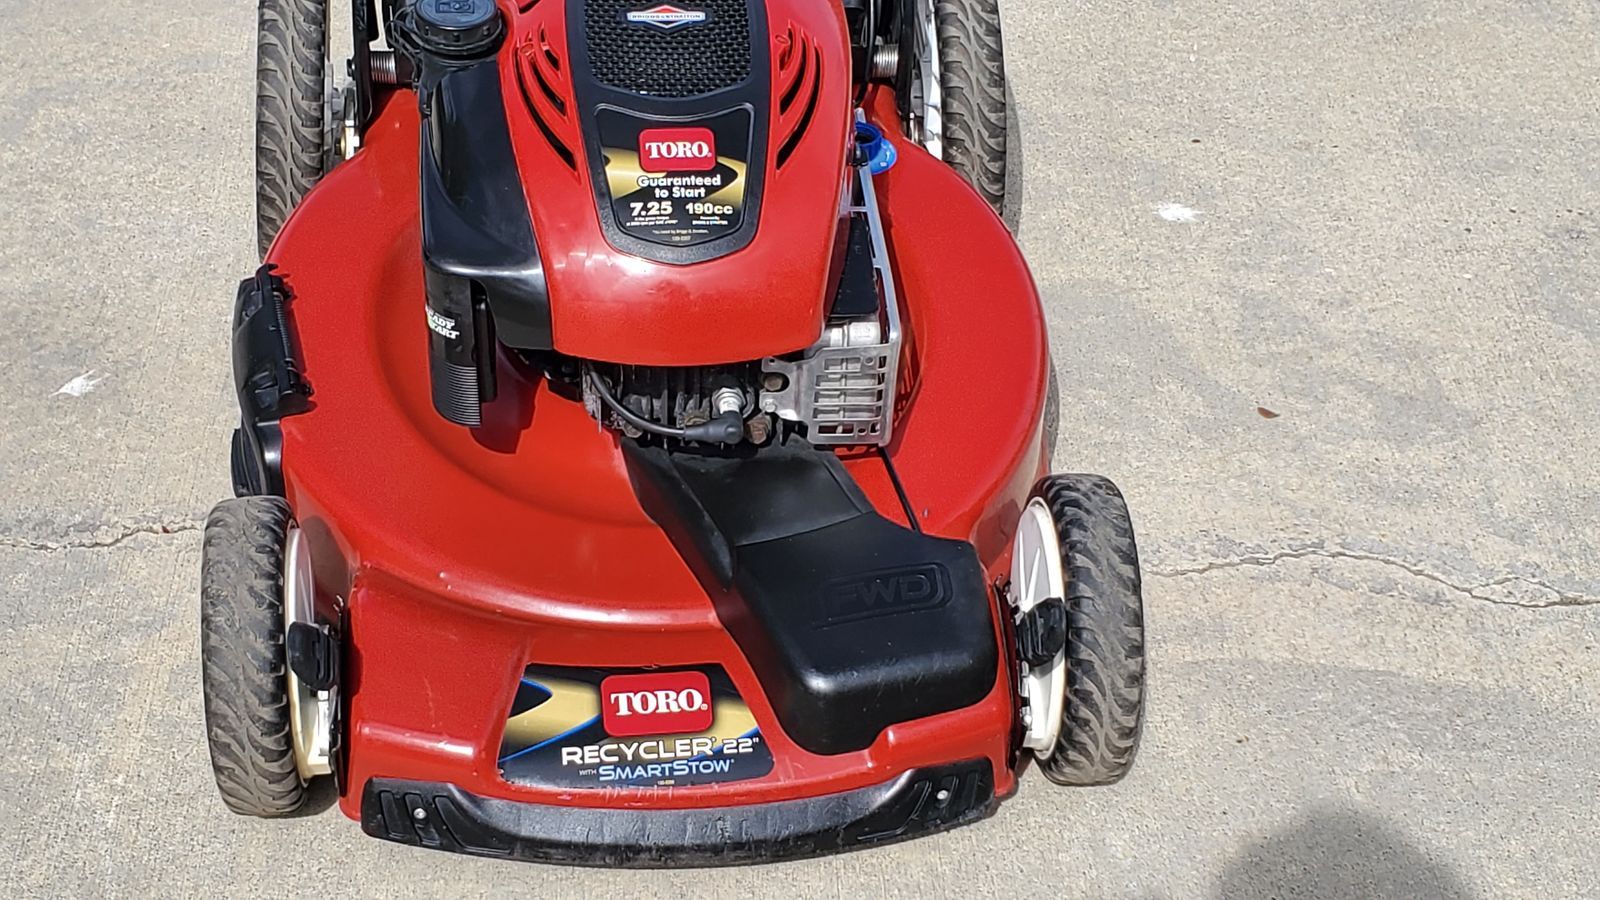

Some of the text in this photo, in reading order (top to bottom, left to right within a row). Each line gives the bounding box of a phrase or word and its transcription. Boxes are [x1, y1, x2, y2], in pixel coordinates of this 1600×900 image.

[645, 141, 710, 159] TORO
[637, 174, 721, 187] Guaranteed
[654, 187, 706, 198] to Start
[629, 201, 734, 217] 7.25 190cc
[610, 689, 705, 716] TORO
[561, 737, 760, 766] RECYCLER 22"
